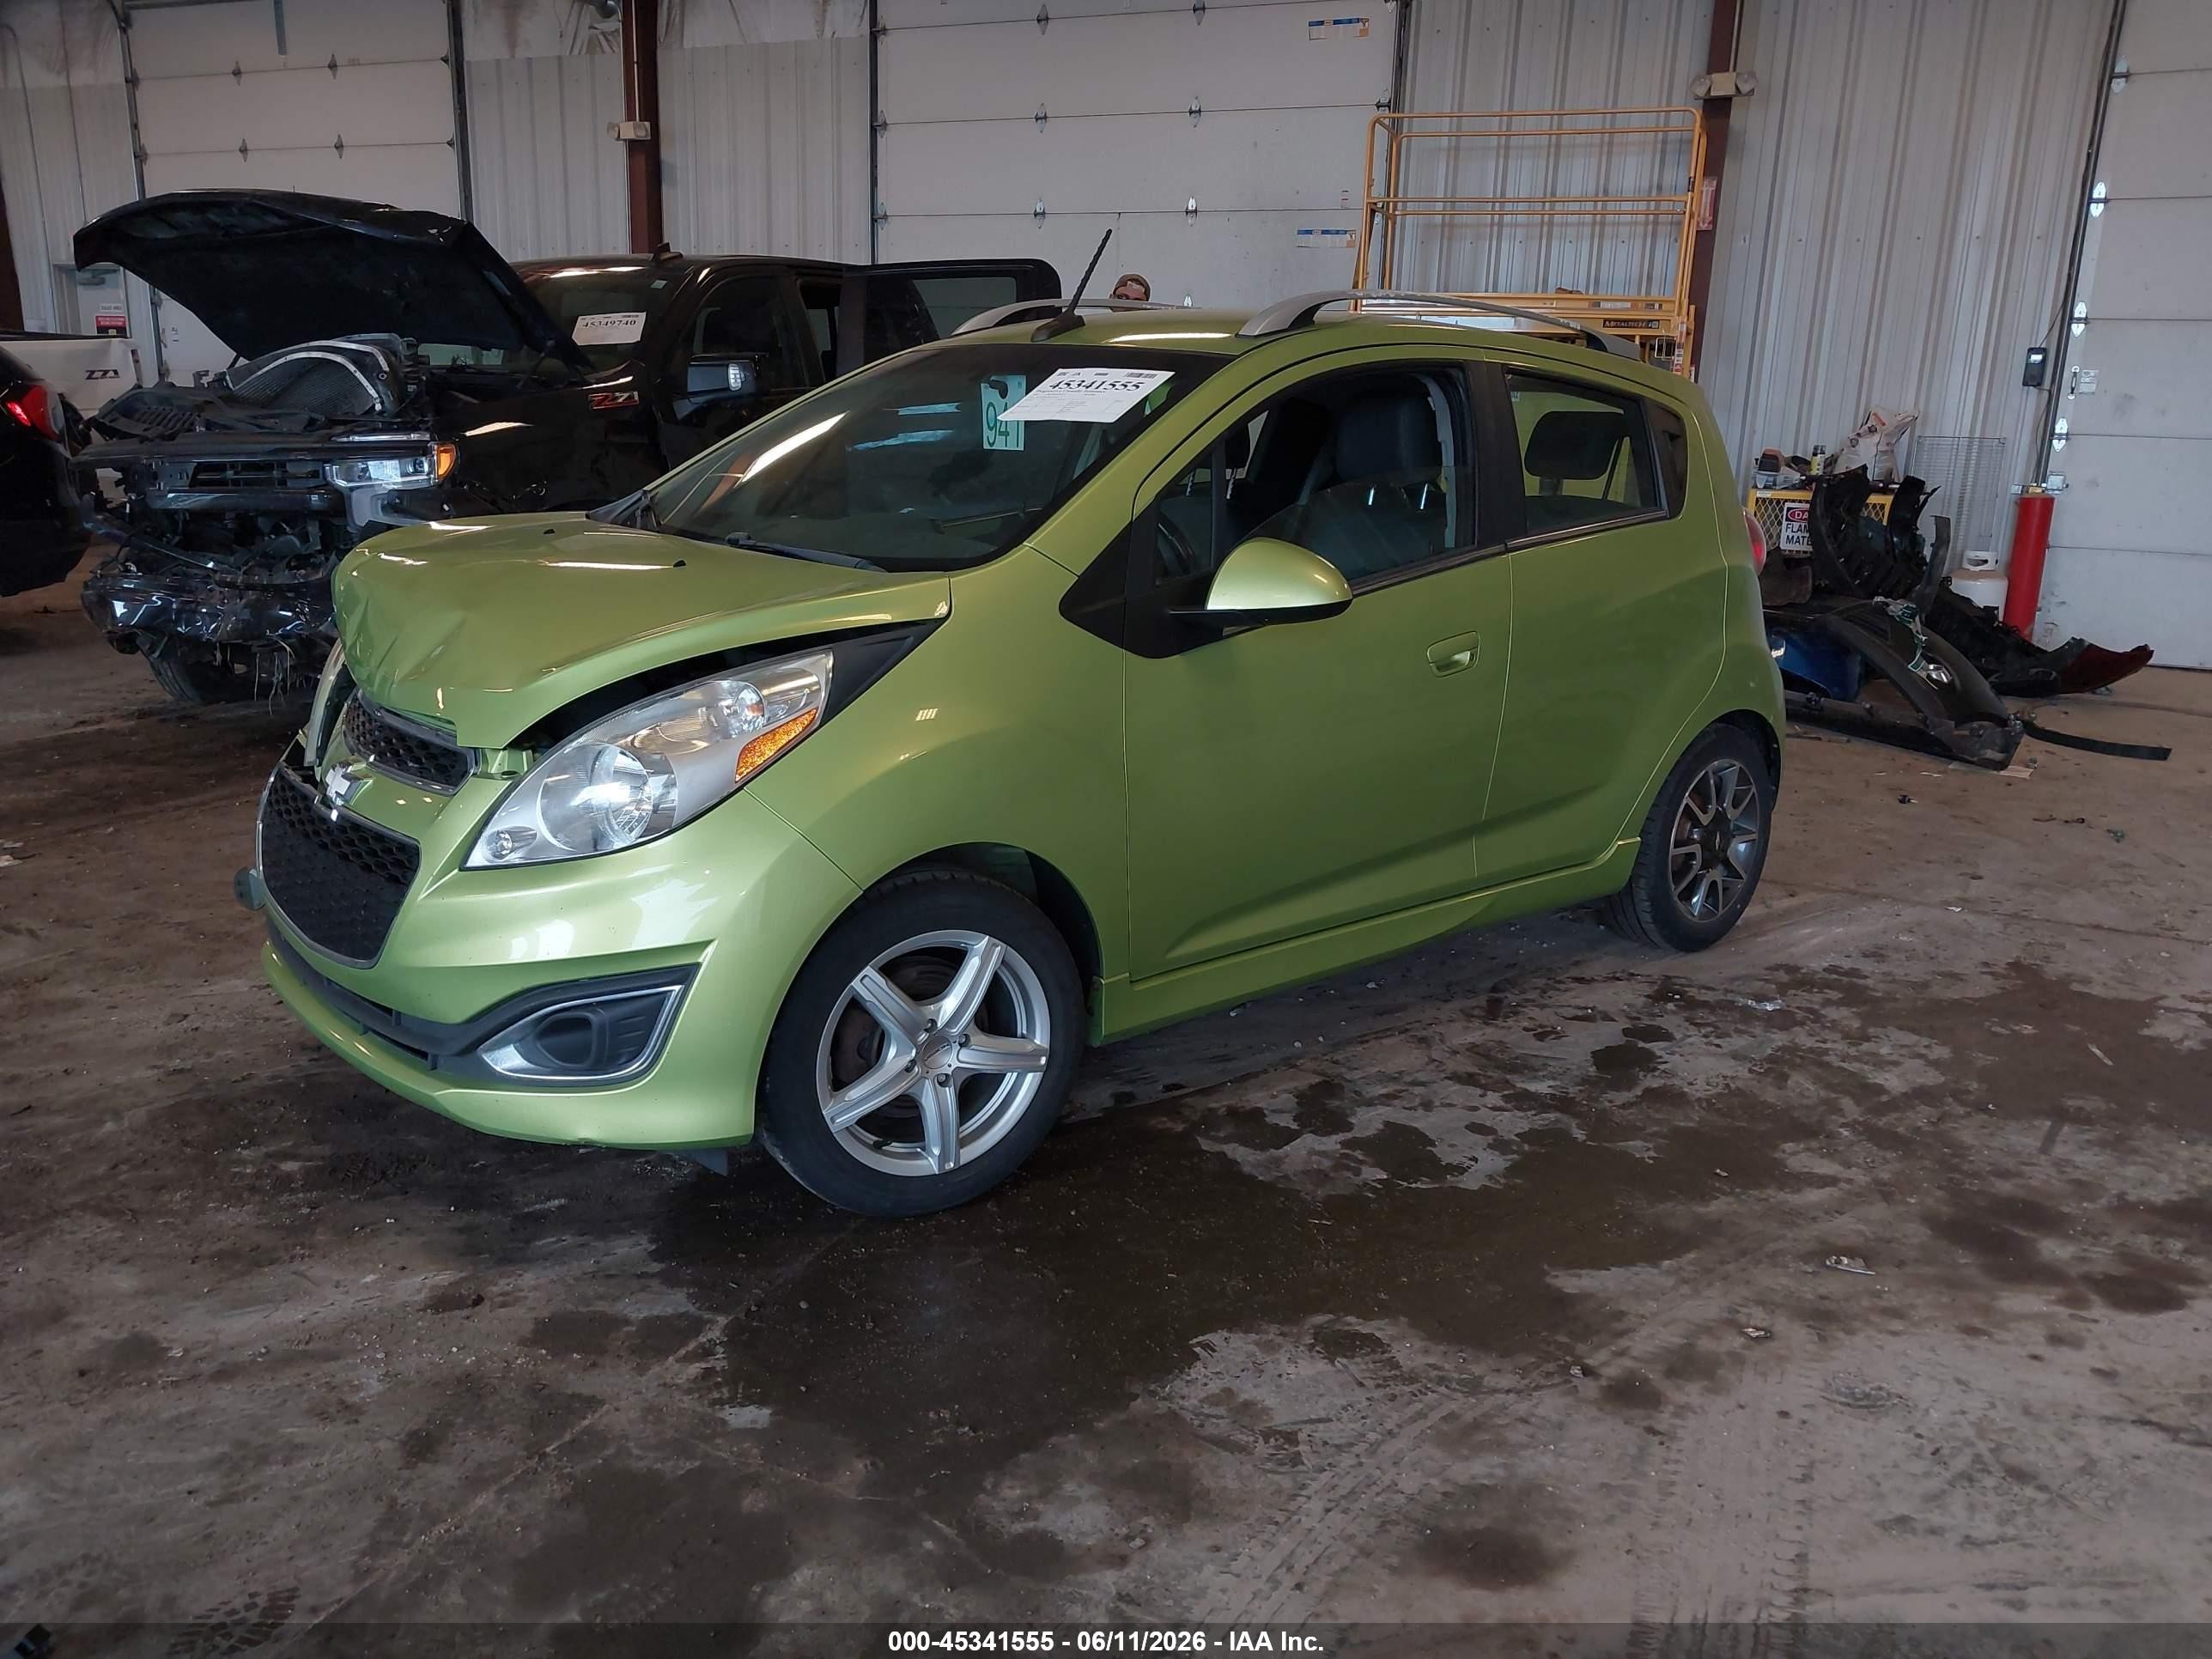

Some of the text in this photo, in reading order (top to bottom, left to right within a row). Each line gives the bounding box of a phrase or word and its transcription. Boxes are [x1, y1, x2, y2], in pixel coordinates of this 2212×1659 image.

[582, 319, 636, 328] 45349740
[1048, 380, 1146, 392] 45341555
[588, 392, 640, 410] Z71
